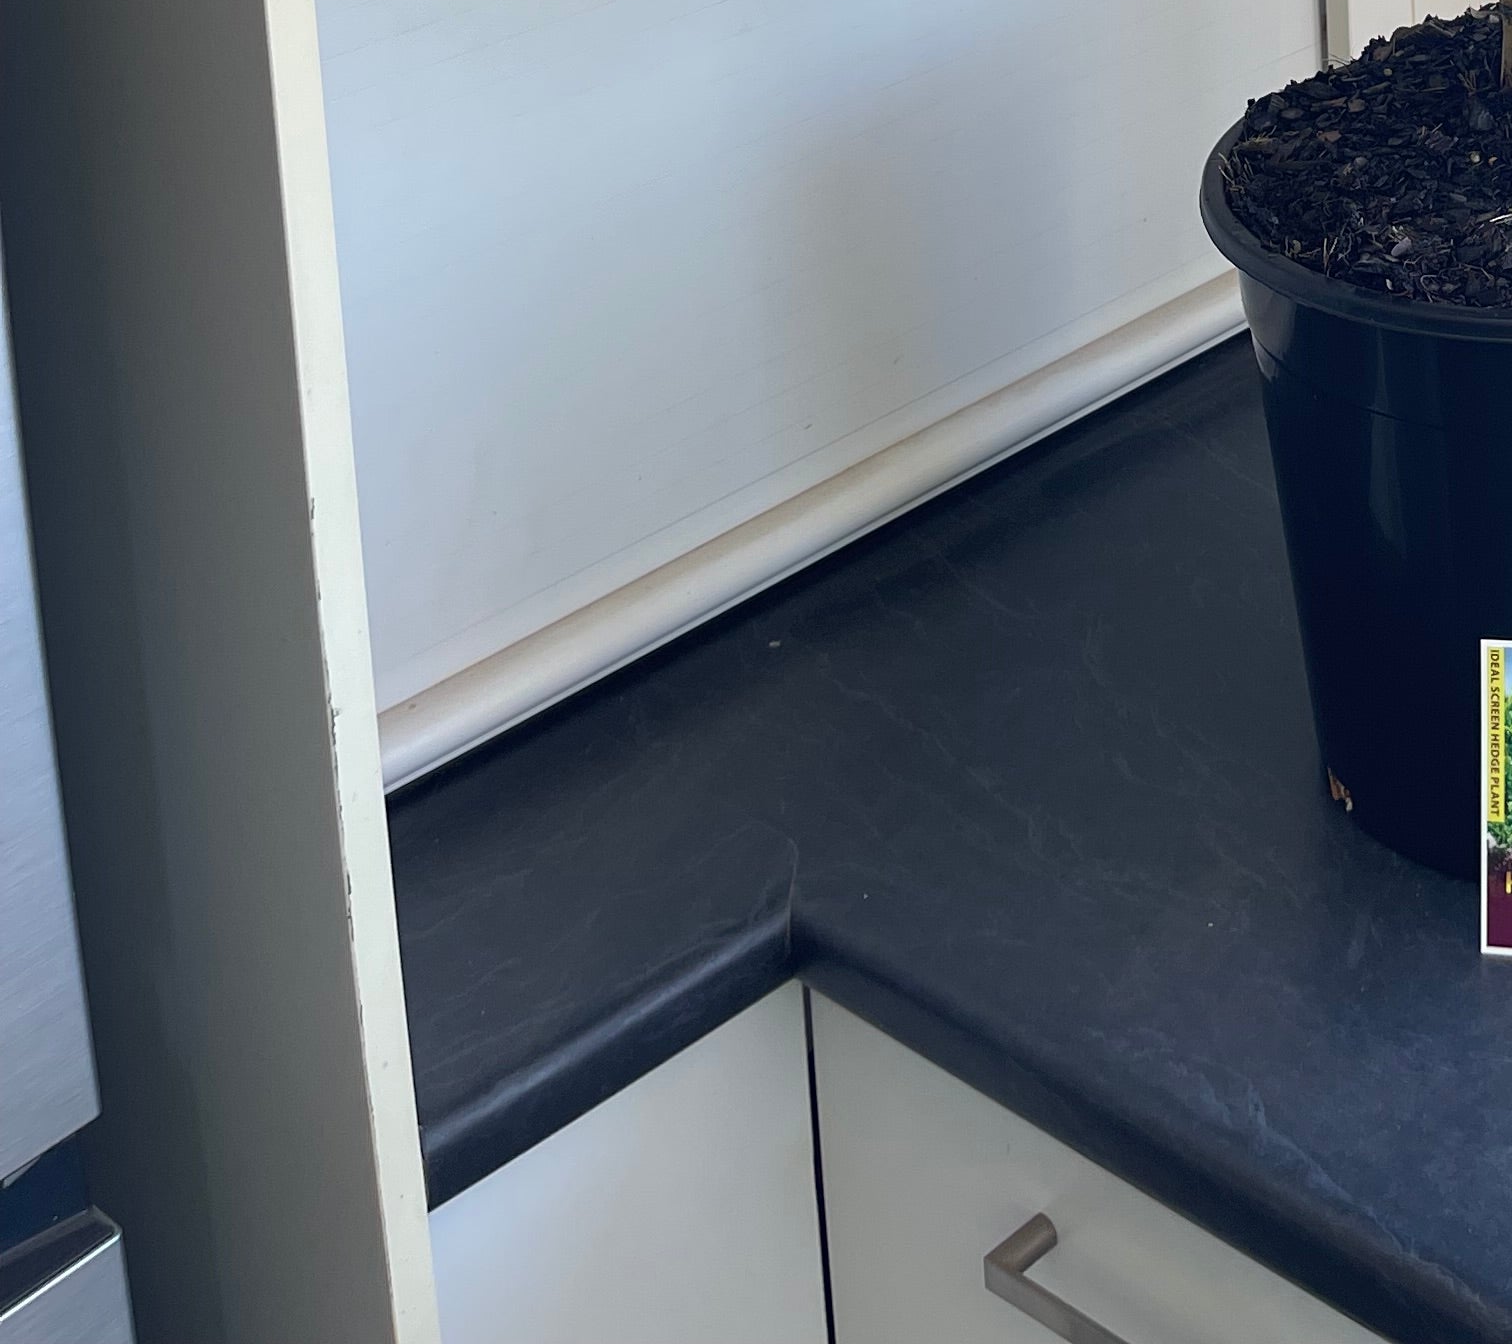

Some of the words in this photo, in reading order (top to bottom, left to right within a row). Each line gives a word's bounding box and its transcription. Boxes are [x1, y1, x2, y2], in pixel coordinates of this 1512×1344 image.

[1489, 649, 1500, 682] IDEAL
[1489, 687, 1500, 731] SCREEN
[1489, 733, 1500, 773] HEDGE
[1489, 776, 1500, 817] PLANT
